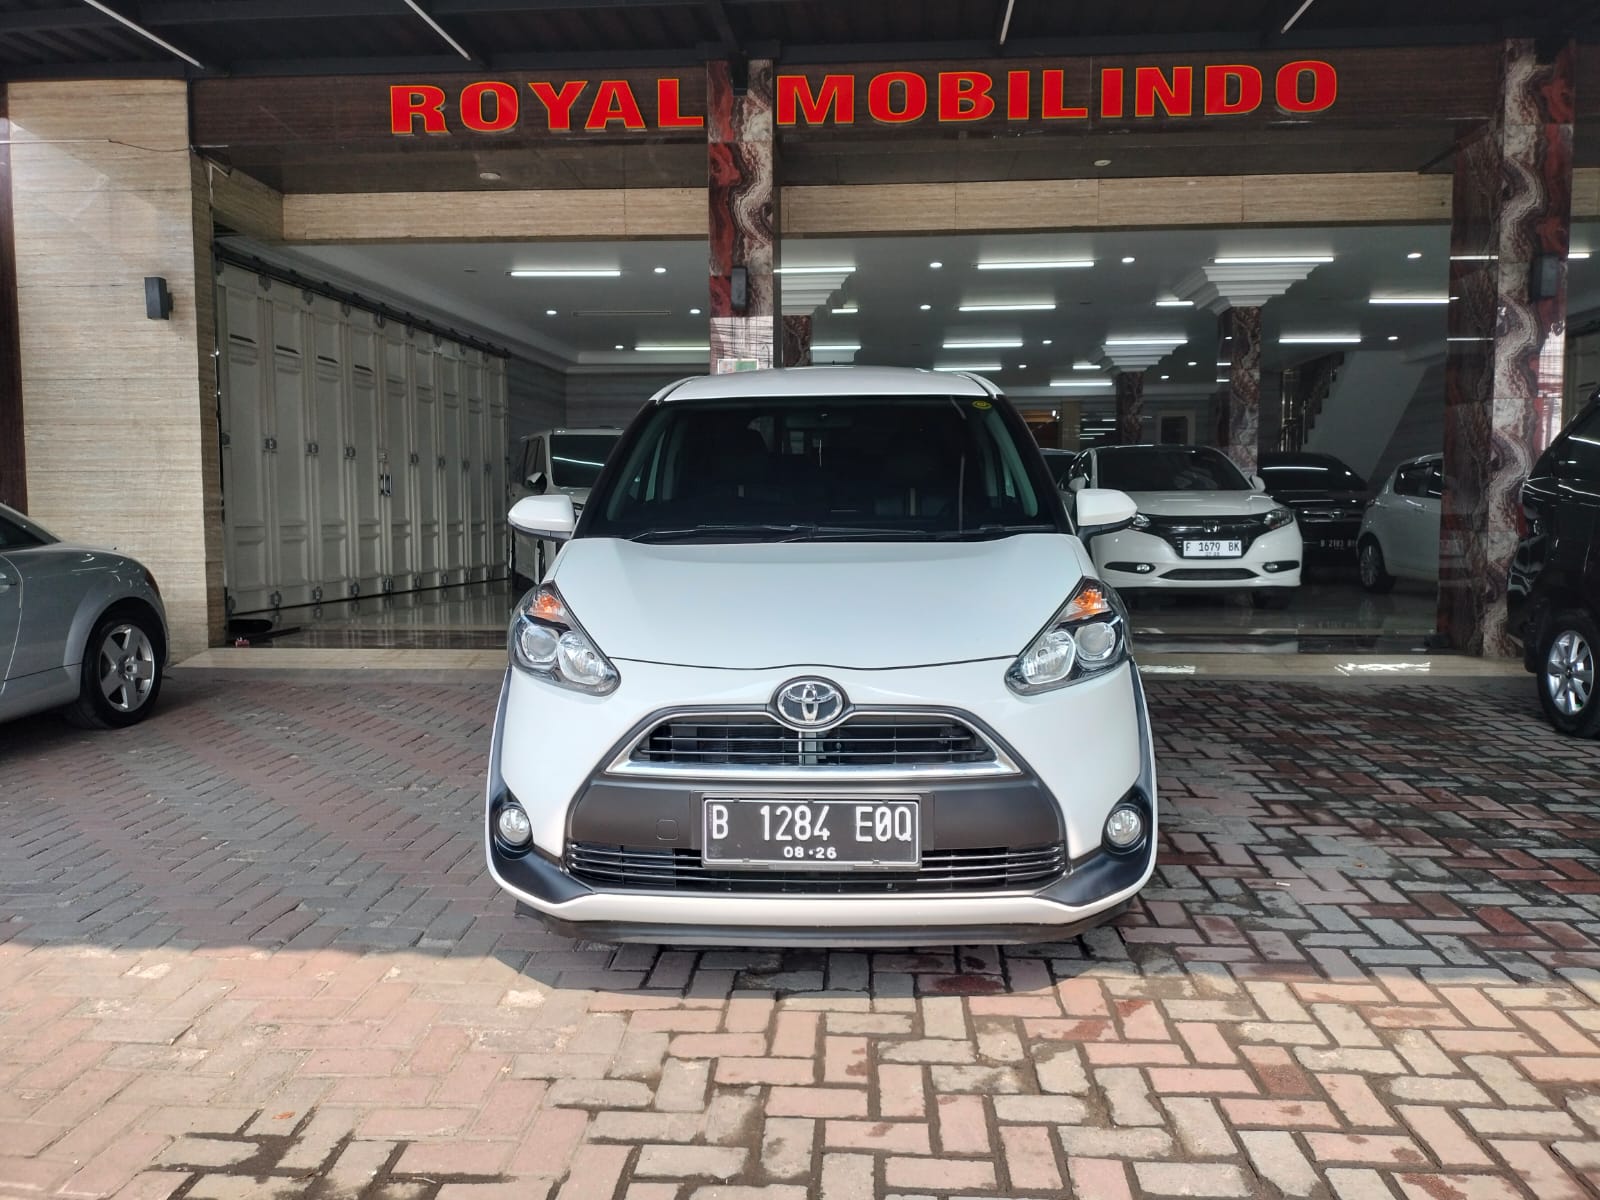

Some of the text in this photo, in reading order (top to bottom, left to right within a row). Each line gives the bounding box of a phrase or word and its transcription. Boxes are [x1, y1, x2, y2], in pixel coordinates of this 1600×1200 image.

[390, 60, 1338, 135] ROYAL MOBILINDO
[1185, 542, 1240, 552] F 1679 BK
[711, 804, 729, 840] B
[759, 805, 831, 841] 1284
